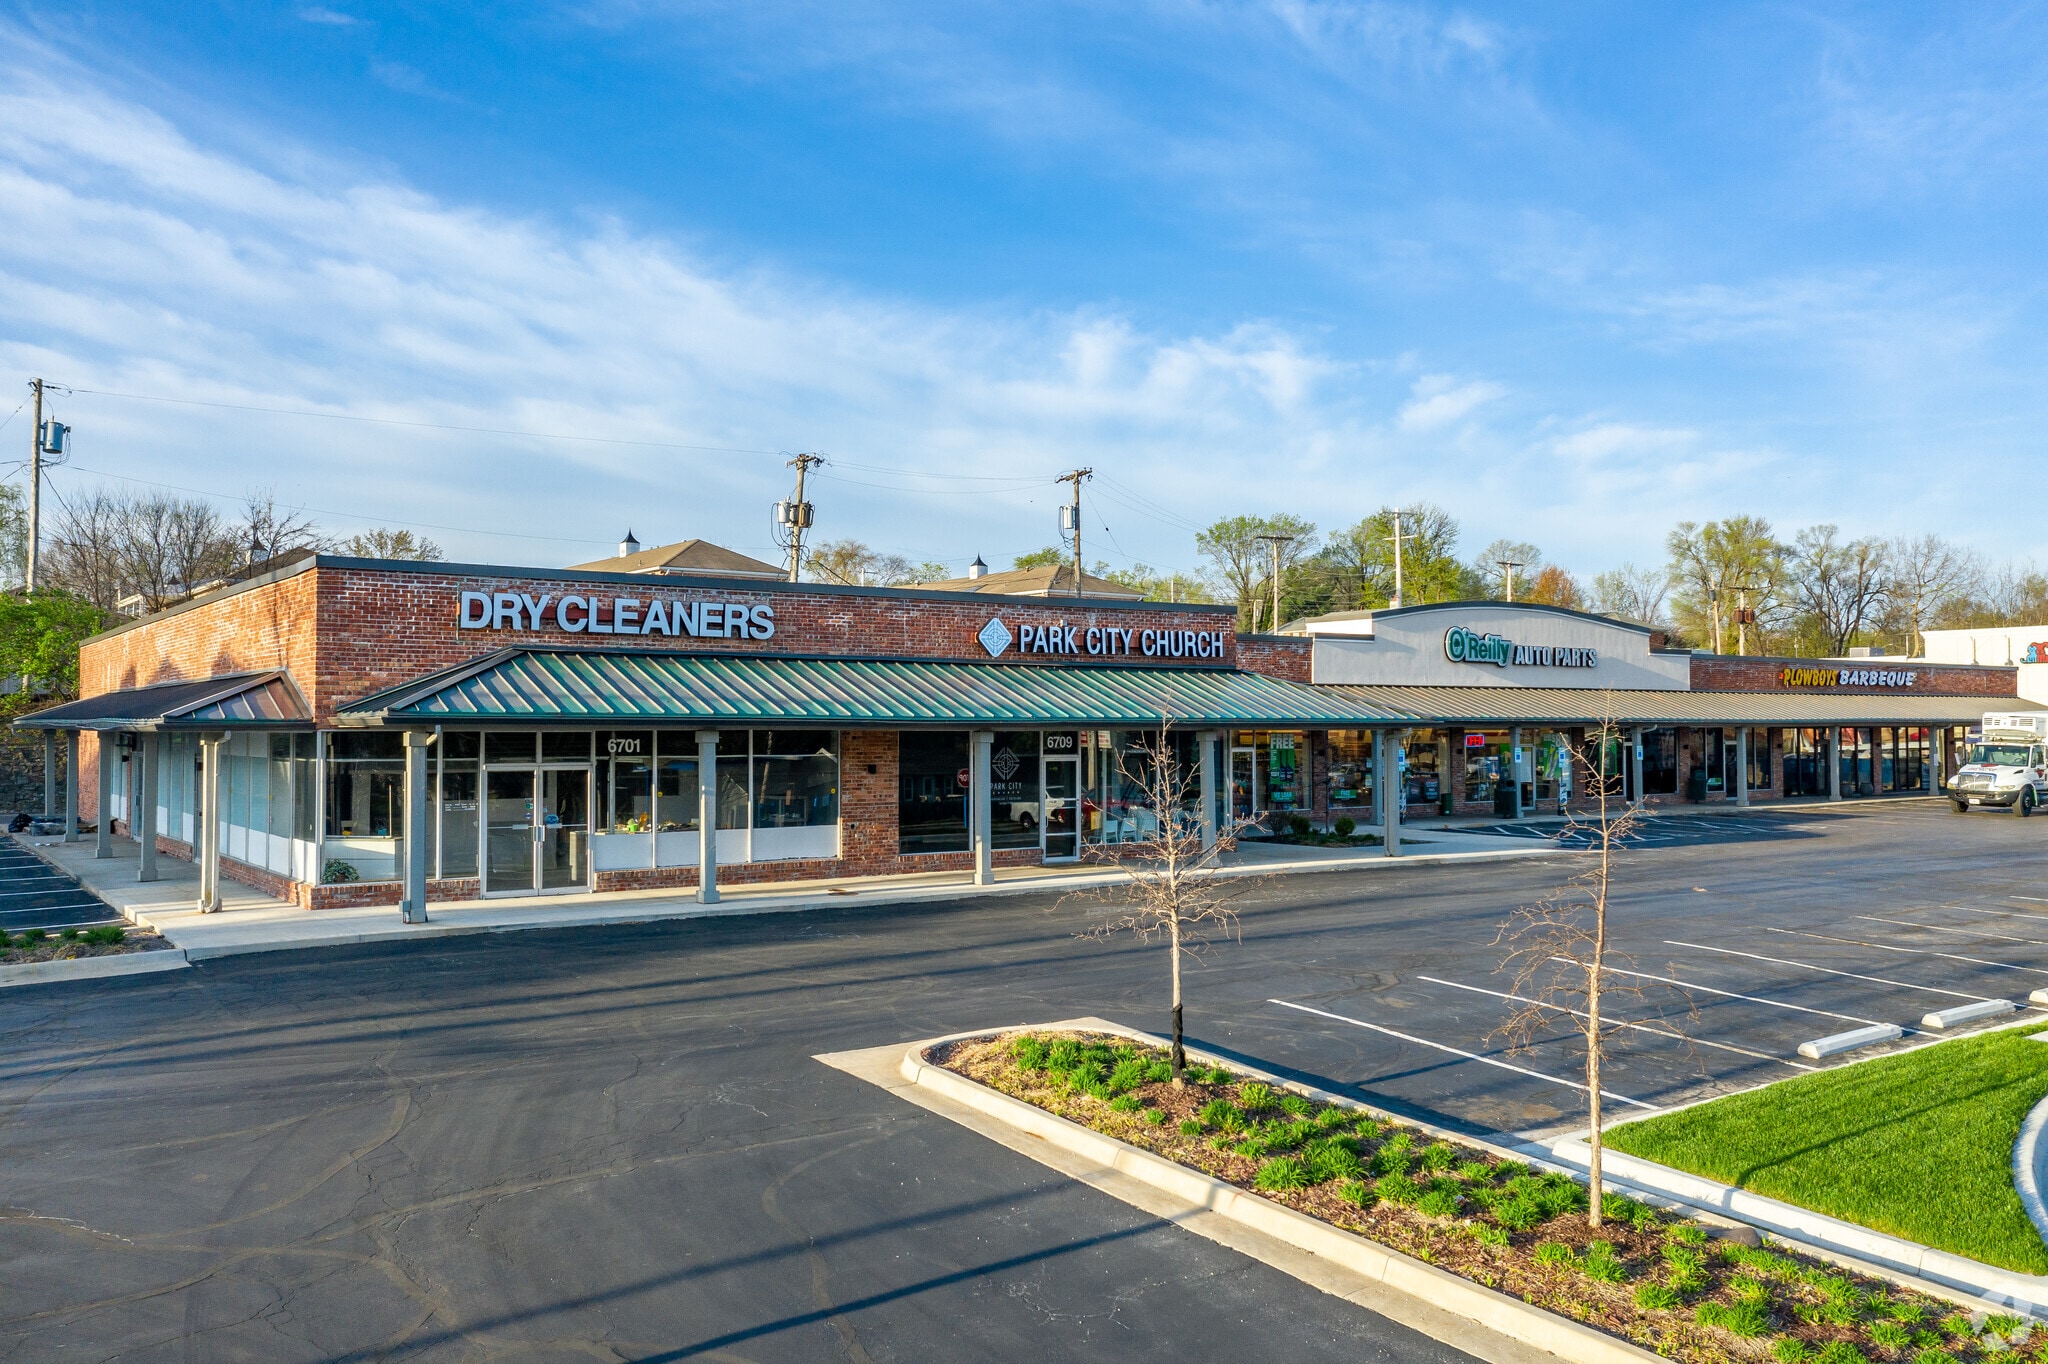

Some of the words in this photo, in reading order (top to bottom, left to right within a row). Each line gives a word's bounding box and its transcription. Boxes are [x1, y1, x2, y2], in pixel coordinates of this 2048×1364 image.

[460, 591, 550, 631] DRY
[556, 595, 775, 640] CLEANERS
[1019, 625, 1079, 654] PARK
[1086, 627, 1134, 655] CITY
[1141, 629, 1225, 658] CHURCH
[1447, 628, 1511, 666] O'Reilly
[1515, 646, 1551, 666] AUTO
[1555, 647, 1597, 668] PARTS
[1783, 668, 1839, 687] PLOWBOYS
[1839, 669, 1916, 687] BARBEQUE
[607, 738, 641, 753] 6701
[1047, 736, 1073, 748] 6709
[1270, 733, 1295, 749] FREE
[990, 782, 1006, 790] PARK
[1008, 782, 1022, 790] CITY
